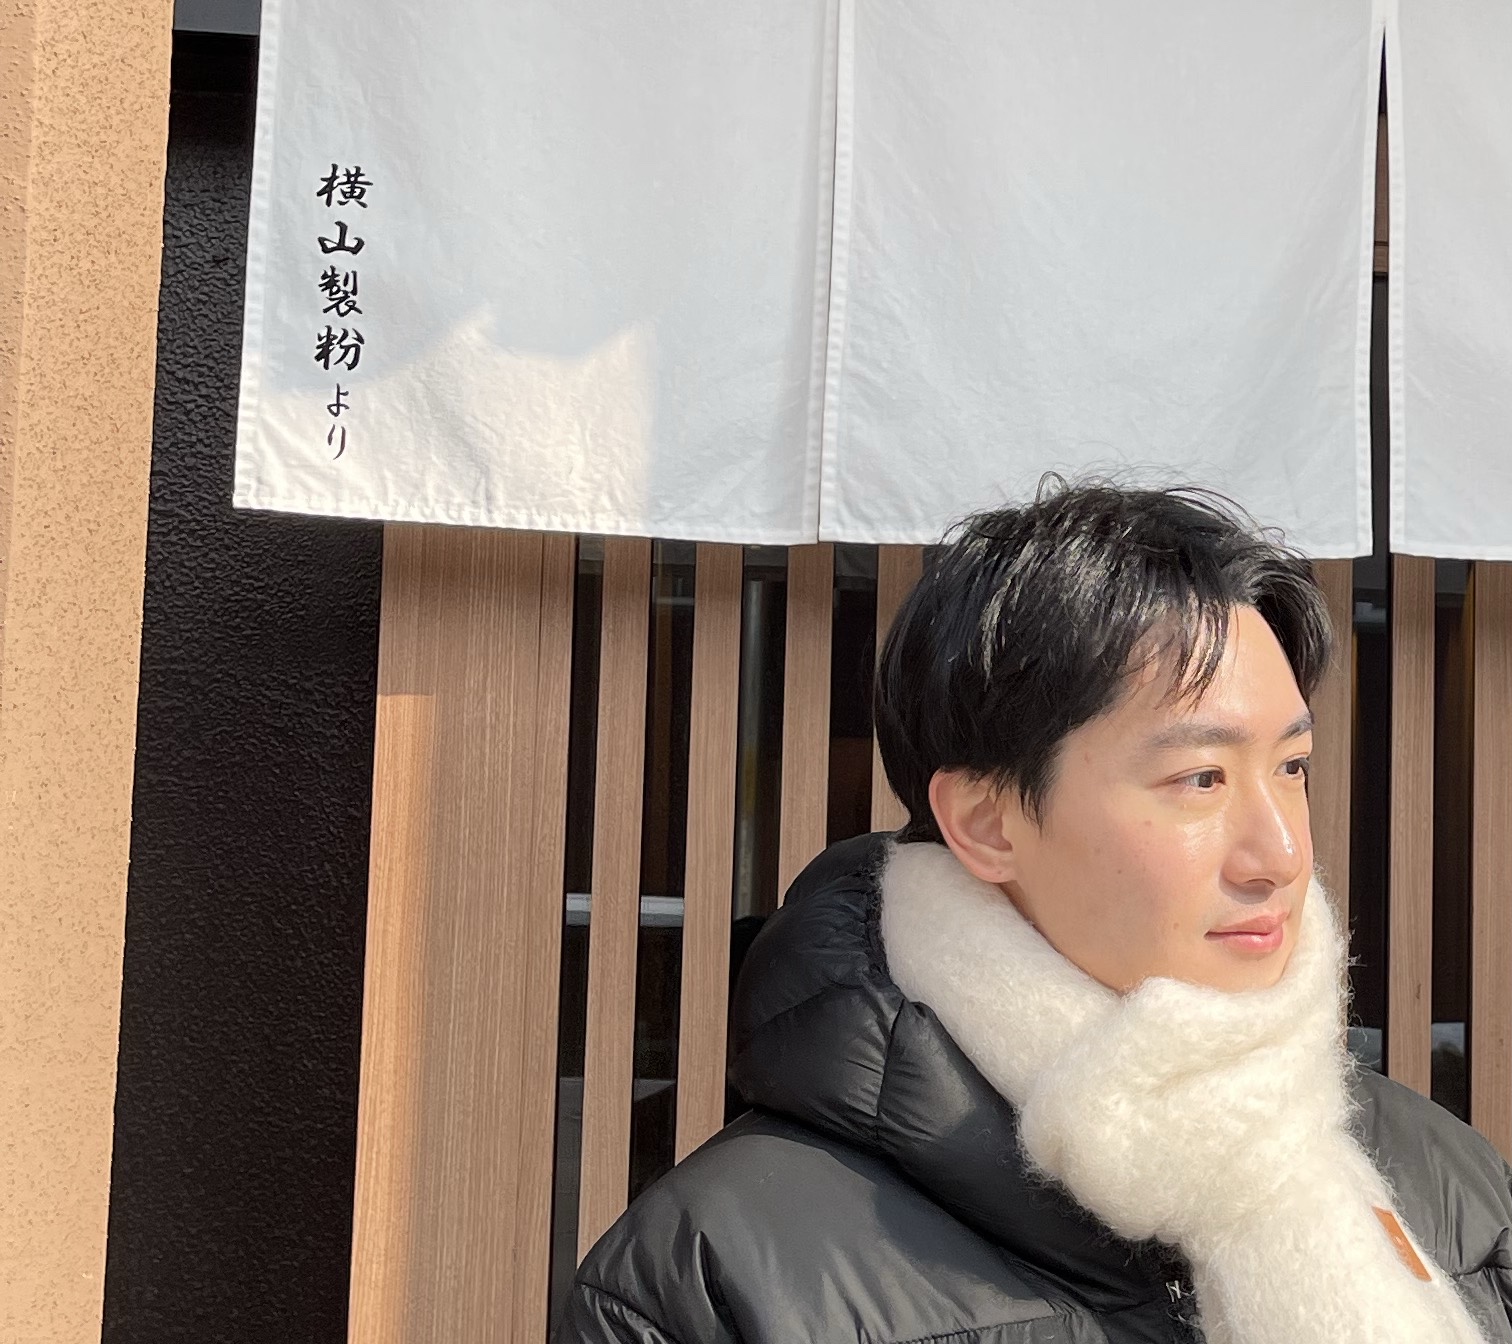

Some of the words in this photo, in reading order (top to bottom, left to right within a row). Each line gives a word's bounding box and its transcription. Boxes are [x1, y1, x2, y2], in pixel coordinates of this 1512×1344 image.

[314, 163, 373, 460] 横山製粉より
